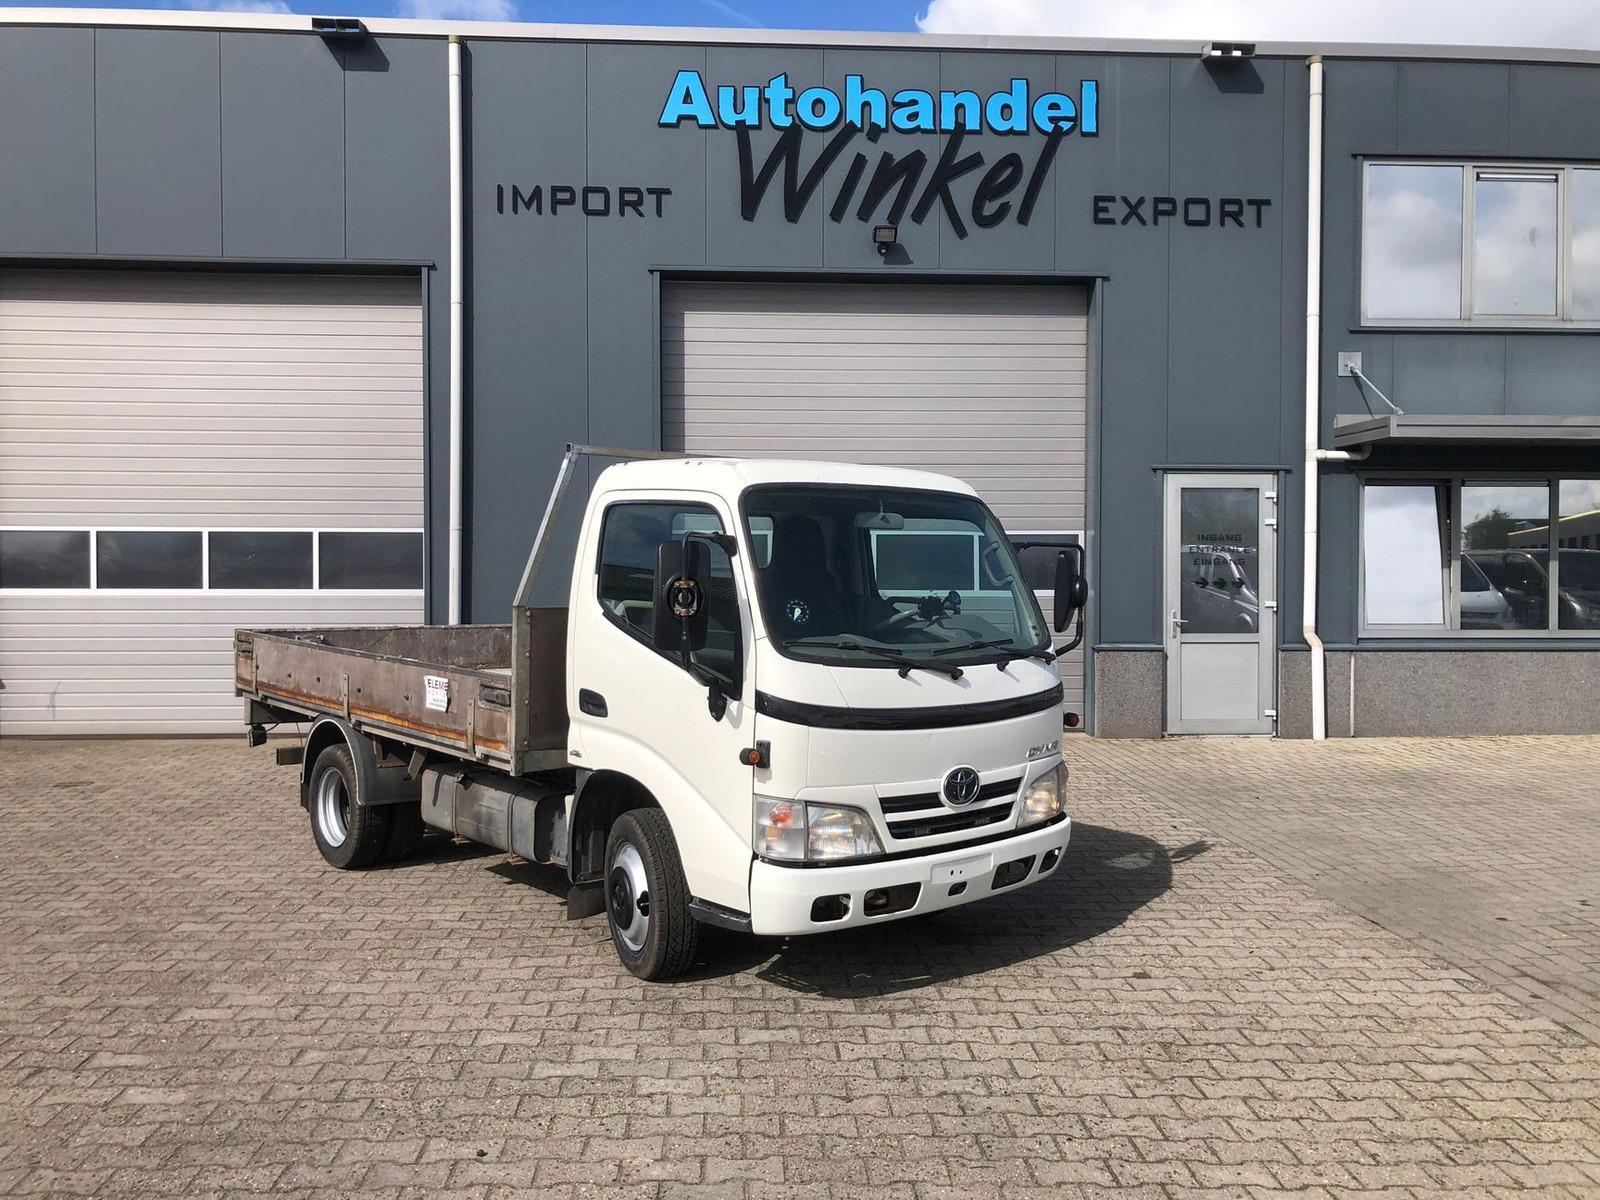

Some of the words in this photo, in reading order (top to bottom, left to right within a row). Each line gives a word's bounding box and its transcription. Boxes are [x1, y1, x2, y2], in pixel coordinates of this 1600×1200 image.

[658, 70, 1099, 136] Autohandel
[735, 119, 1064, 240] Winkel
[495, 183, 673, 219] IMPORT
[1092, 194, 1272, 229] EXPORT
[1197, 533, 1242, 542] INGANG
